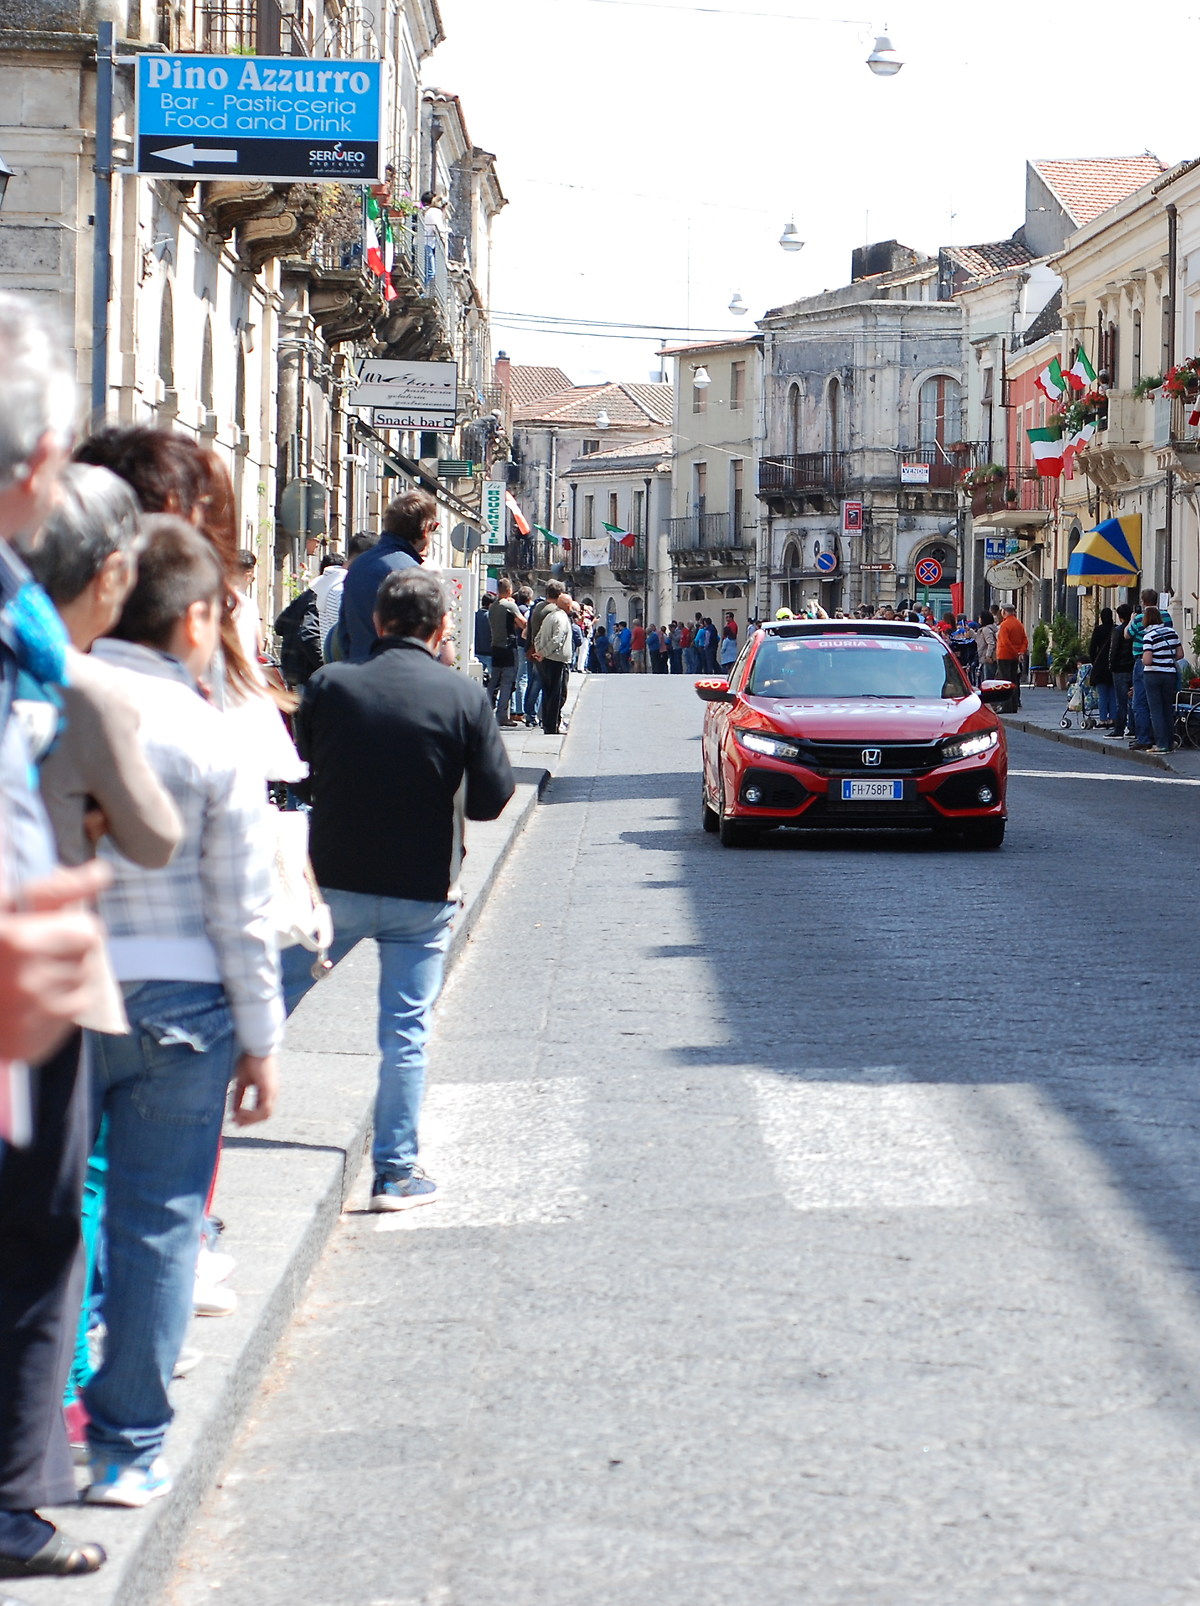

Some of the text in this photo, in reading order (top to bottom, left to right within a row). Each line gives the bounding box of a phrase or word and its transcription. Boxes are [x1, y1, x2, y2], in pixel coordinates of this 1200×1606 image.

[147, 58, 371, 94] Pino Azzurro
[160, 93, 199, 110] Bar
[224, 95, 357, 114] Pasticceria
[165, 112, 352, 132] Food and Drink
[309, 150, 366, 162] SERMEO
[376, 413, 441, 428] Snack bar
